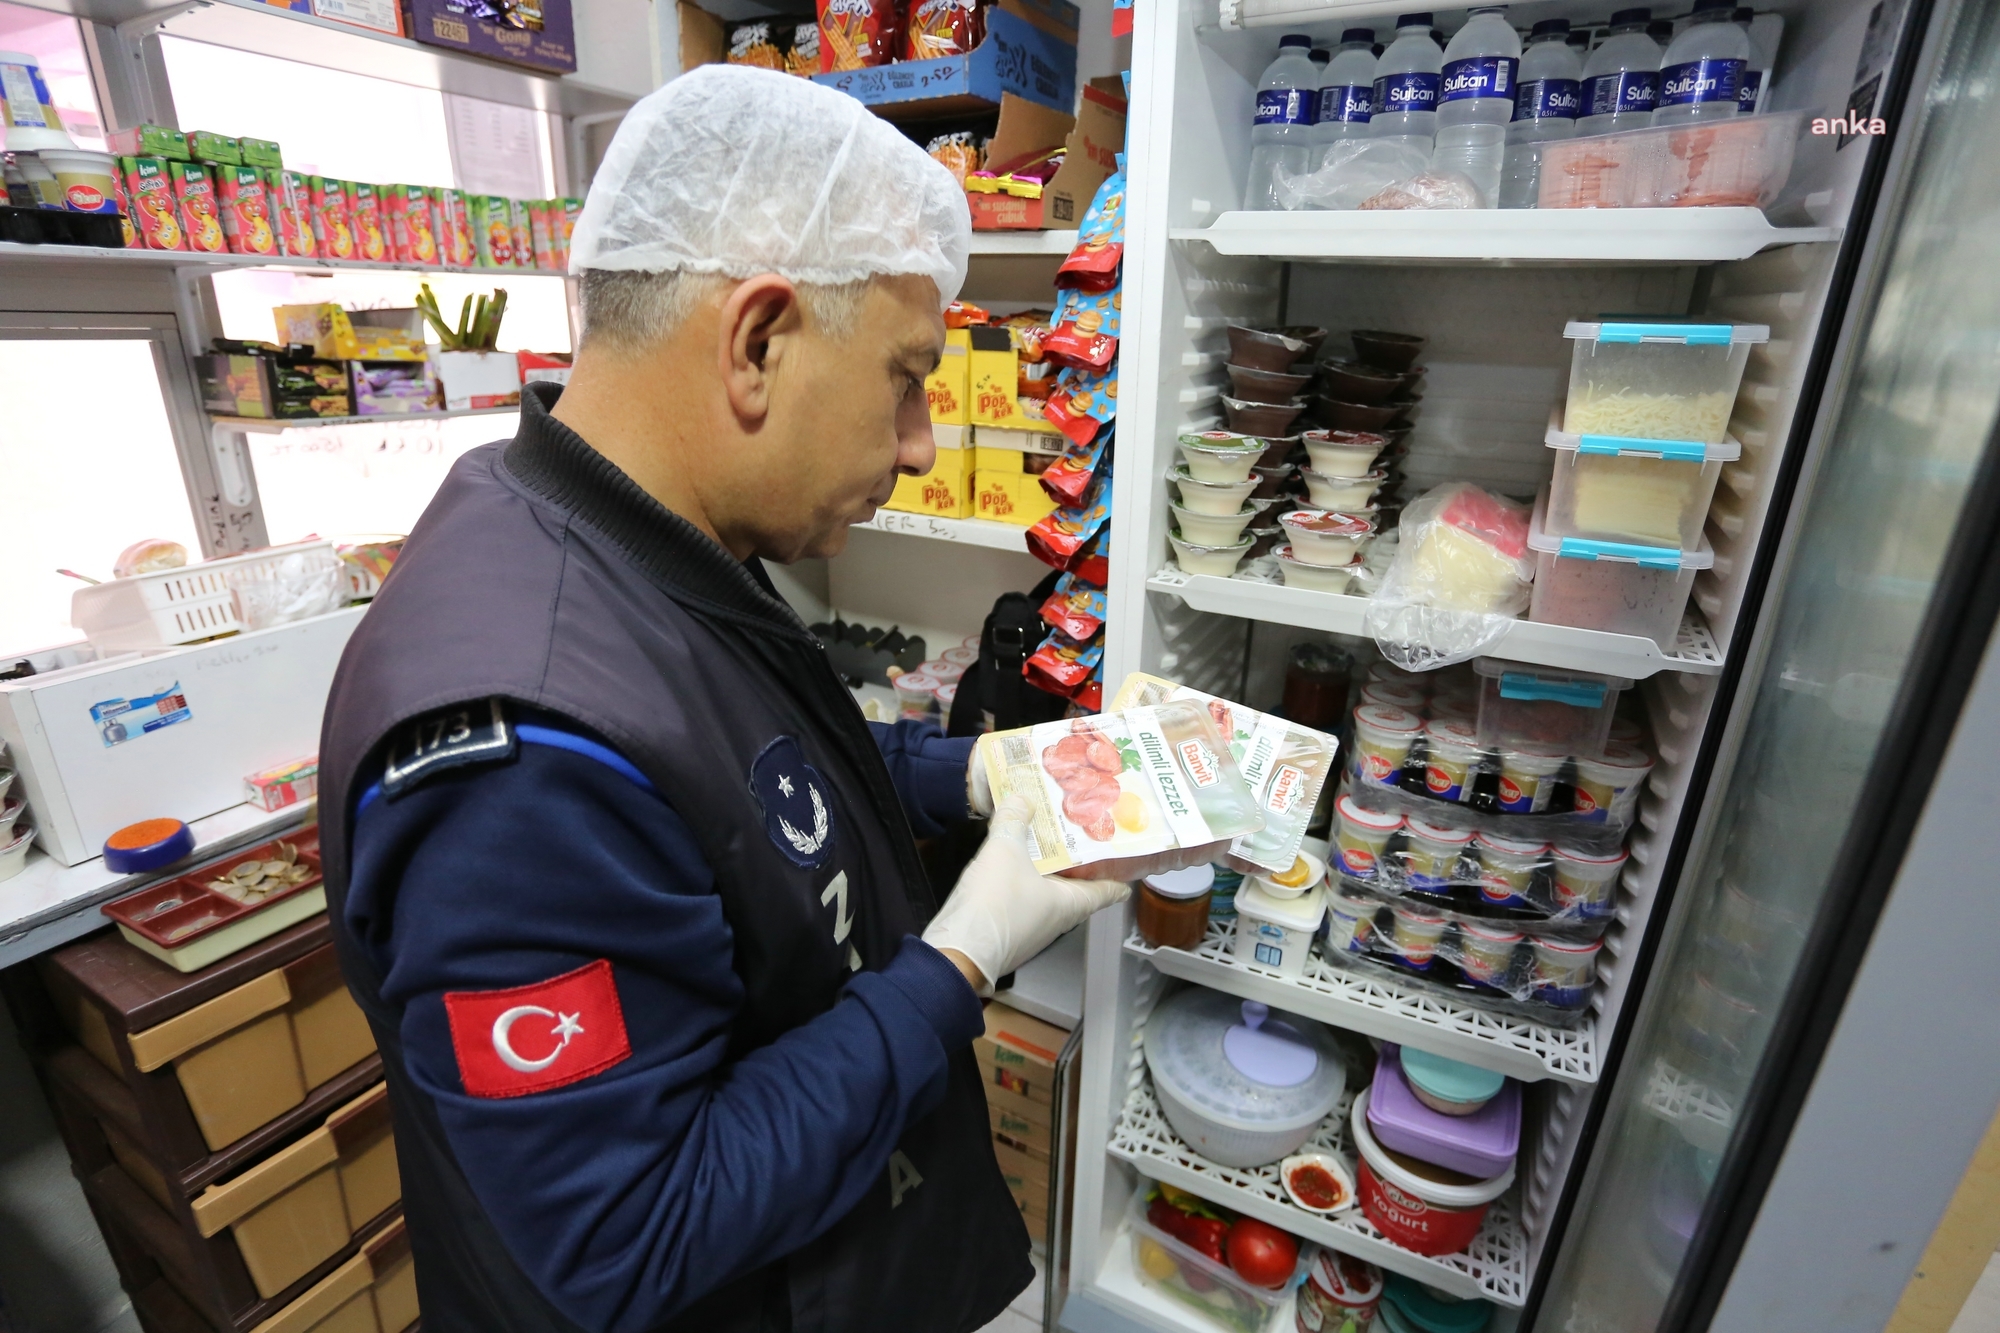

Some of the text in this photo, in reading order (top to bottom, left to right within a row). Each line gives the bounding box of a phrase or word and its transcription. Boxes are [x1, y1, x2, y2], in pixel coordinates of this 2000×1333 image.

[1444, 74, 1488, 92] Sultan
[1664, 77, 1716, 96] Sultan
[1390, 86, 1433, 101] Sultan
[1549, 93, 1577, 107] Sulta
[938, 401, 957, 416] kek
[978, 393, 1007, 414] pop
[994, 403, 1013, 418] kek
[922, 485, 949, 505] pop
[937, 494, 955, 511] kek
[979, 491, 1008, 511] pop
[995, 501, 1014, 517] kek
[1182, 743, 1215, 784] Banvit
[1245, 736, 1274, 779] dilimli
[1139, 732, 1189, 817] dilimli lezzet
[1270, 769, 1298, 809] Banvit
